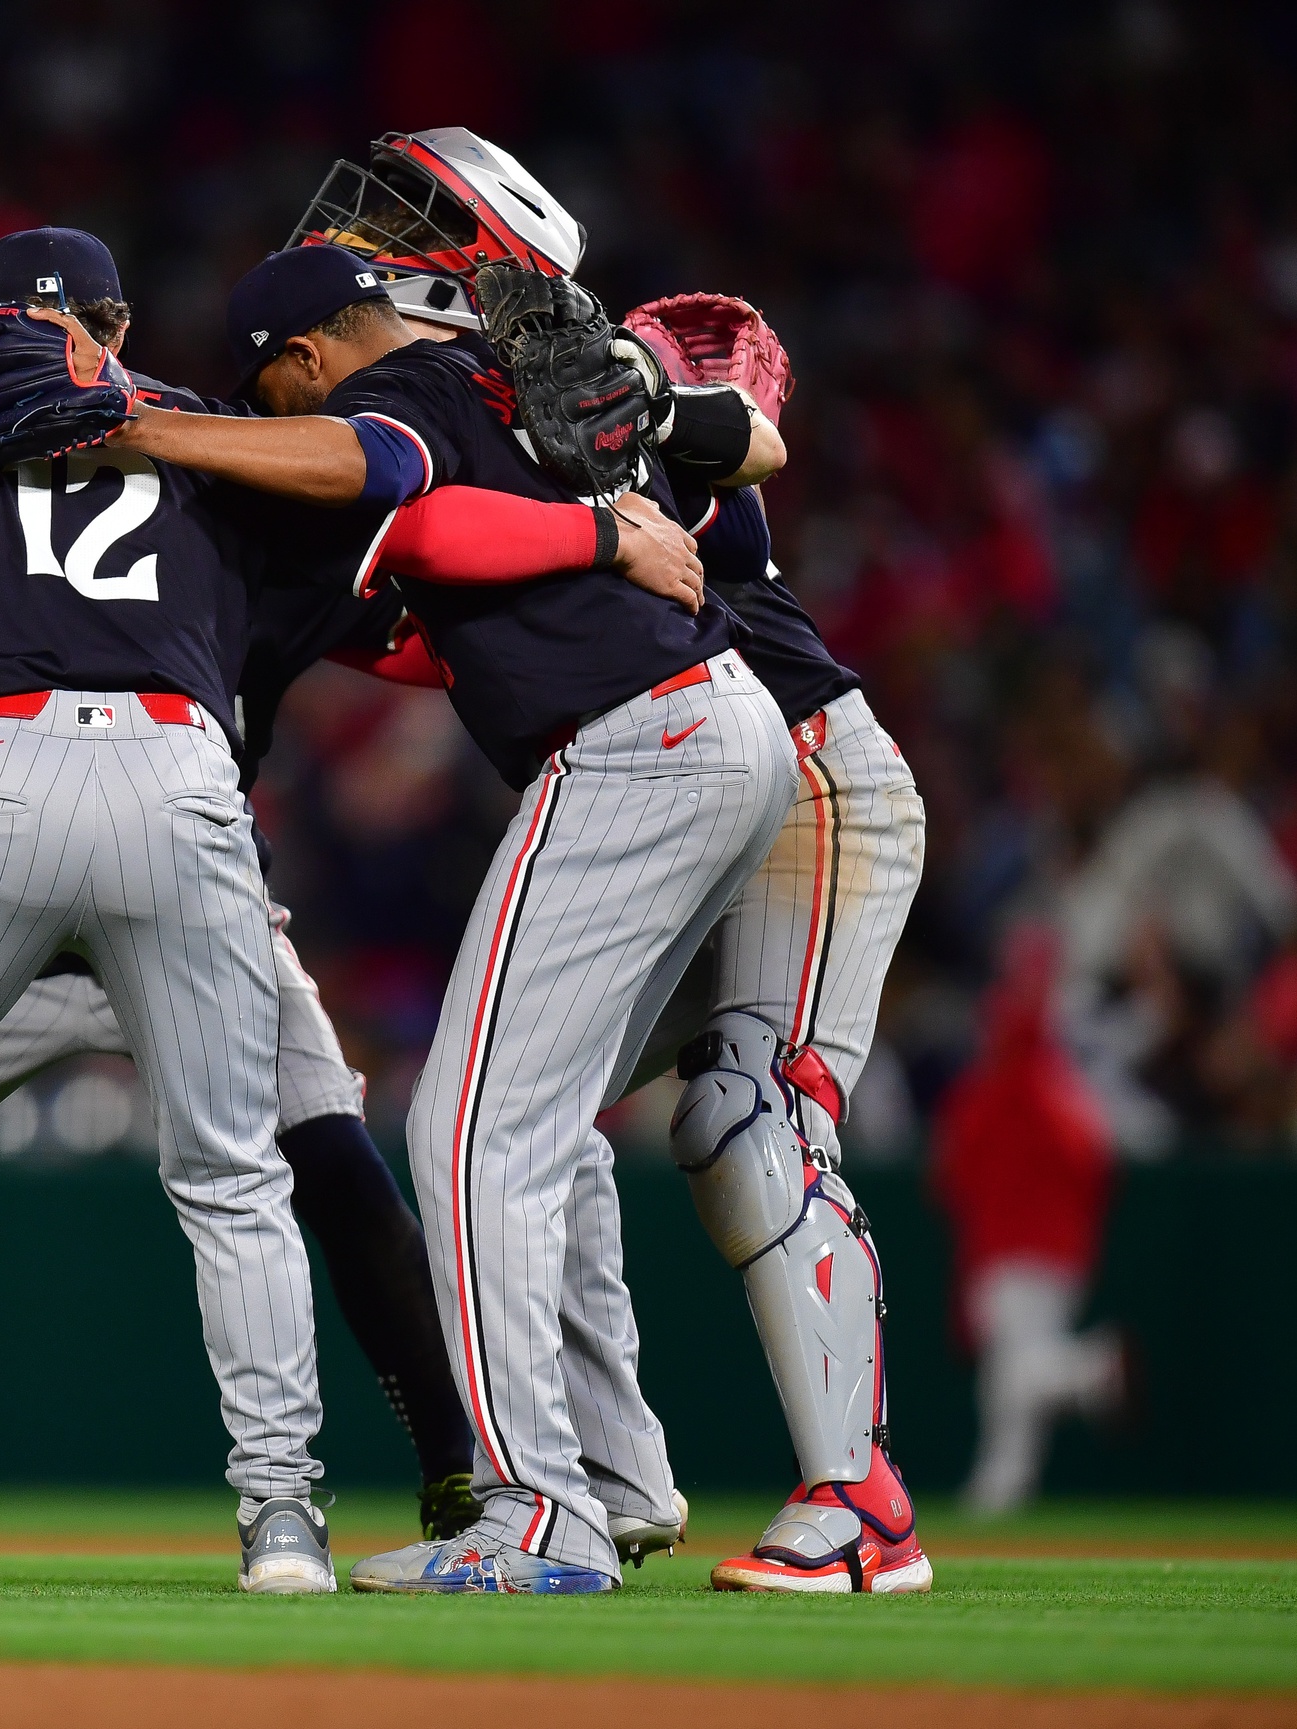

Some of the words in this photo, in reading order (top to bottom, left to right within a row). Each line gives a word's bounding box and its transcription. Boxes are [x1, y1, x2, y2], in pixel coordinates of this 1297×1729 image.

[595, 421, 634, 451] Rawlings
[16, 447, 161, 601] 12
[890, 1498, 903, 1518] RJ
